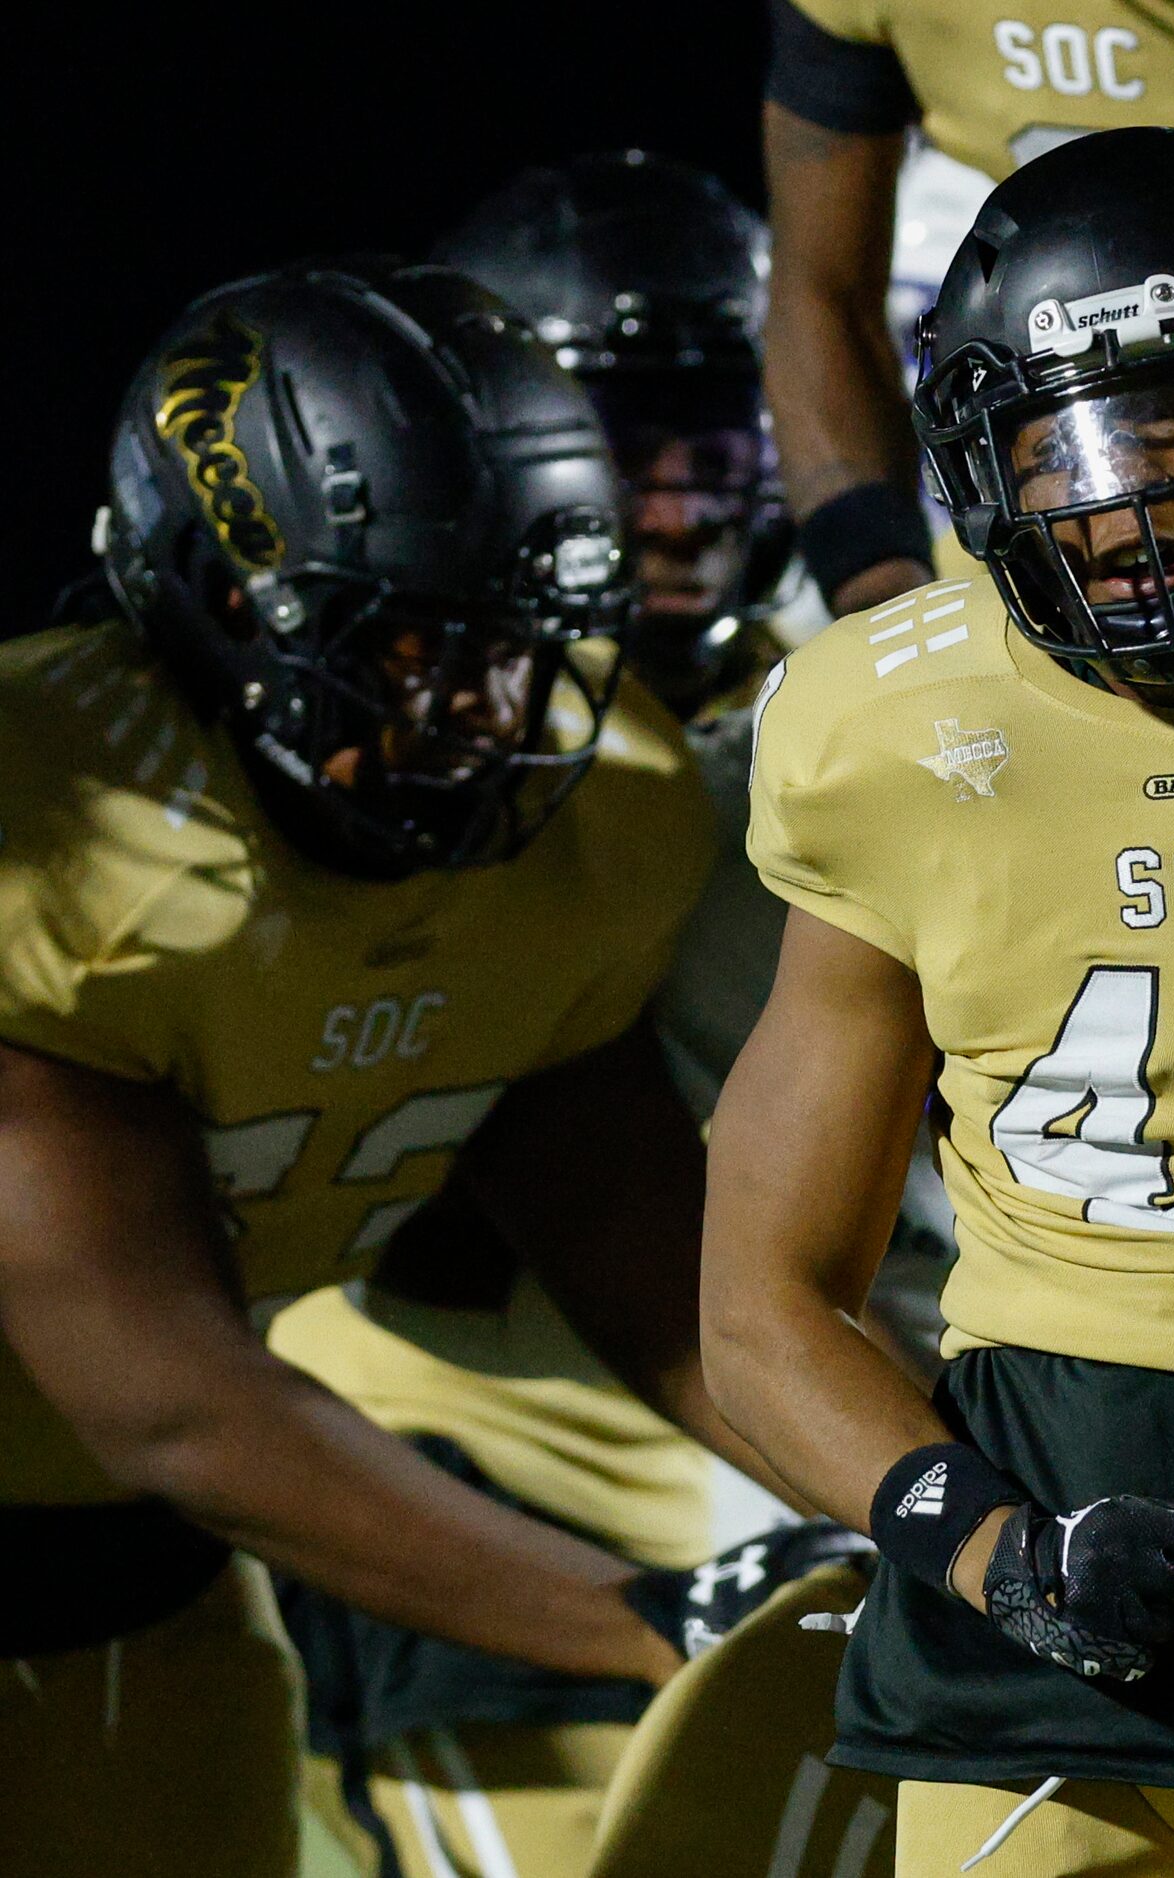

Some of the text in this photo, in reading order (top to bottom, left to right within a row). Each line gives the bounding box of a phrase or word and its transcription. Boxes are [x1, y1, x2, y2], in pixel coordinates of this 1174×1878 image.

[994, 19, 1146, 101] SOC
[1078, 303, 1140, 329] schutt
[944, 738, 1005, 766] MECCA
[309, 990, 446, 1073] SOC
[896, 1461, 948, 1519] adidas
